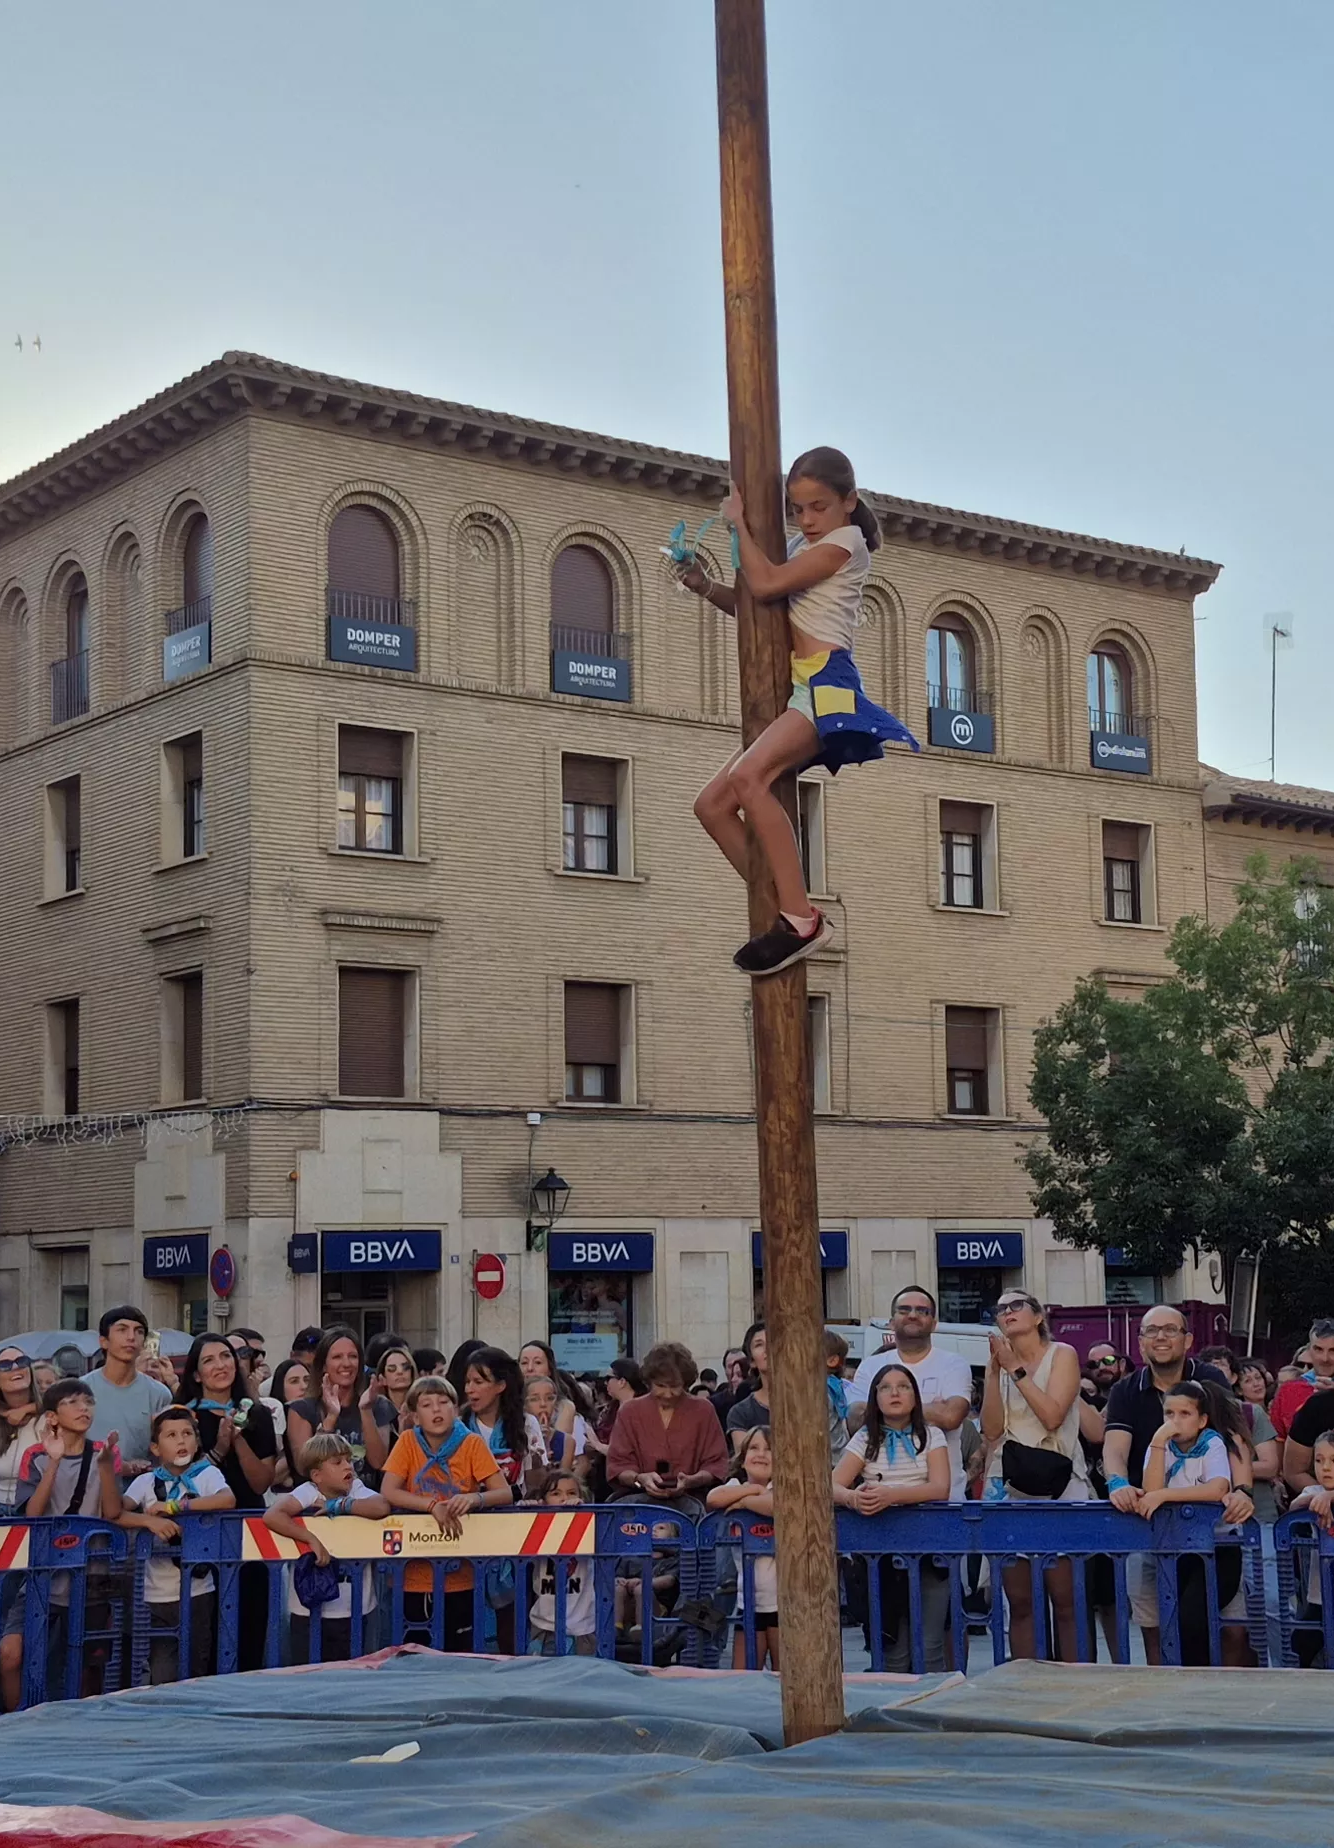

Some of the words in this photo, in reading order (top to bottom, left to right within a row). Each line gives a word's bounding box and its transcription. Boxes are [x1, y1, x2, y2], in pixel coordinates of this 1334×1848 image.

[171, 636, 200, 657] DOMPER
[347, 628, 401, 648] DOMPER
[348, 643, 400, 657] ARQUITECTURA
[569, 661, 617, 680] DOMPER
[570, 675, 617, 688] ARQUITECTURA
[156, 1244, 191, 1268] BBVA
[293, 1247, 310, 1259] BBVA
[350, 1238, 415, 1263] BBVA
[572, 1241, 630, 1262] BBVA
[957, 1240, 1004, 1260] BBVA
